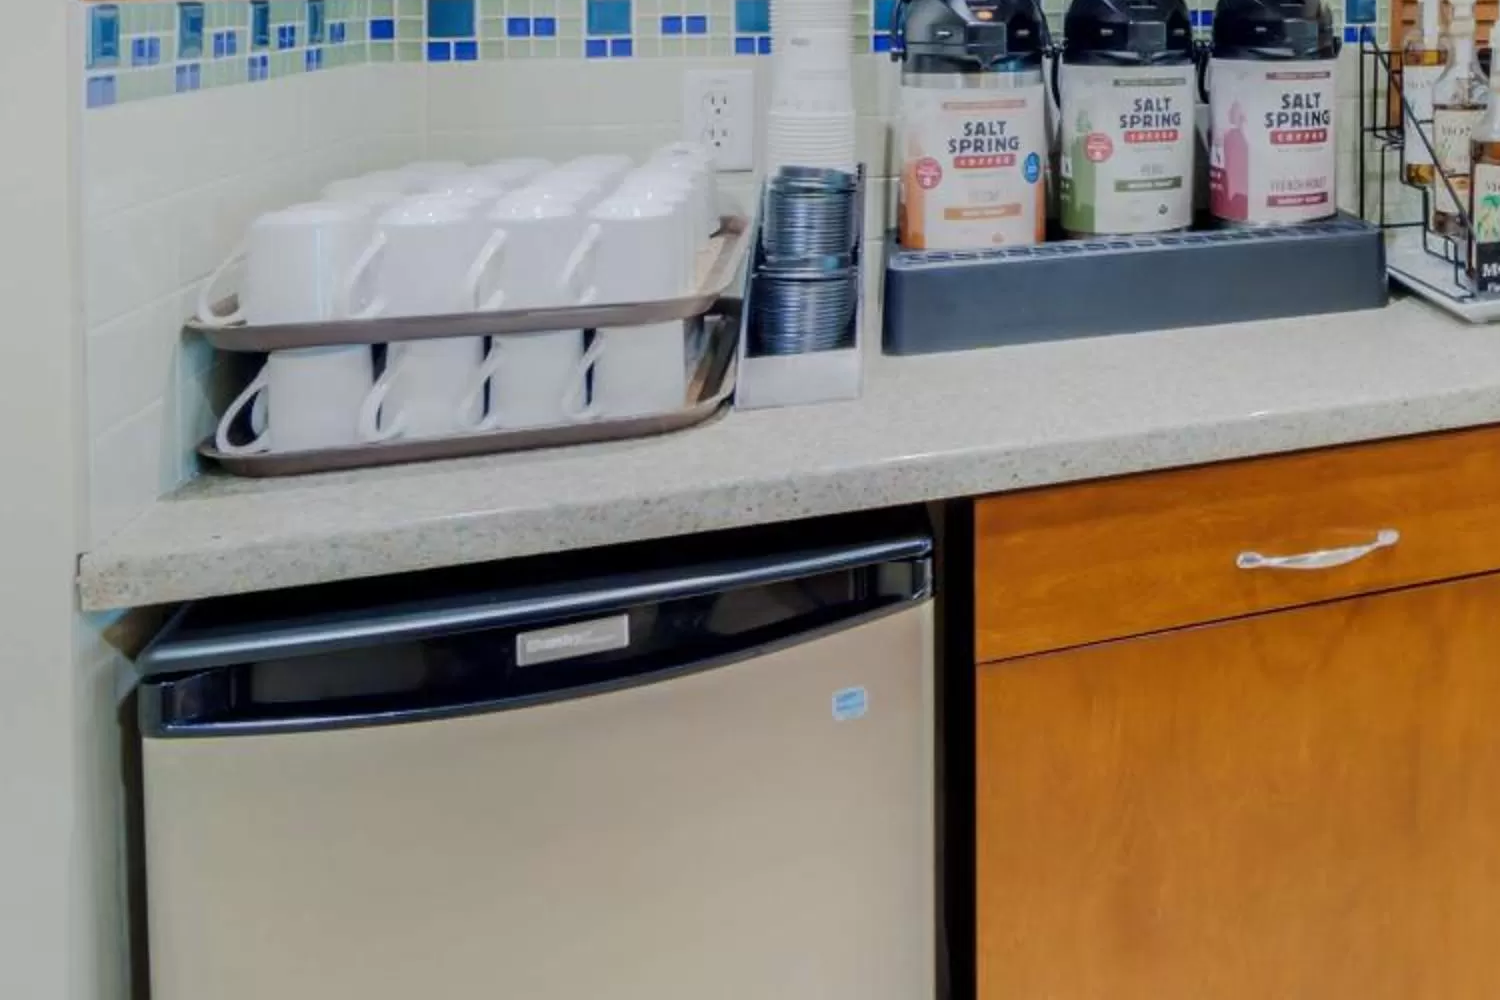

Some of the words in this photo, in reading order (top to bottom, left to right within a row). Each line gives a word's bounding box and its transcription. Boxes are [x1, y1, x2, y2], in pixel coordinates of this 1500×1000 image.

[1133, 97, 1172, 113] SALT
[1282, 91, 1322, 110] SALT
[1119, 112, 1182, 129] SPRING
[1264, 109, 1332, 129] SPRING
[963, 120, 1007, 137] SALT
[947, 136, 1020, 154] SPRING
